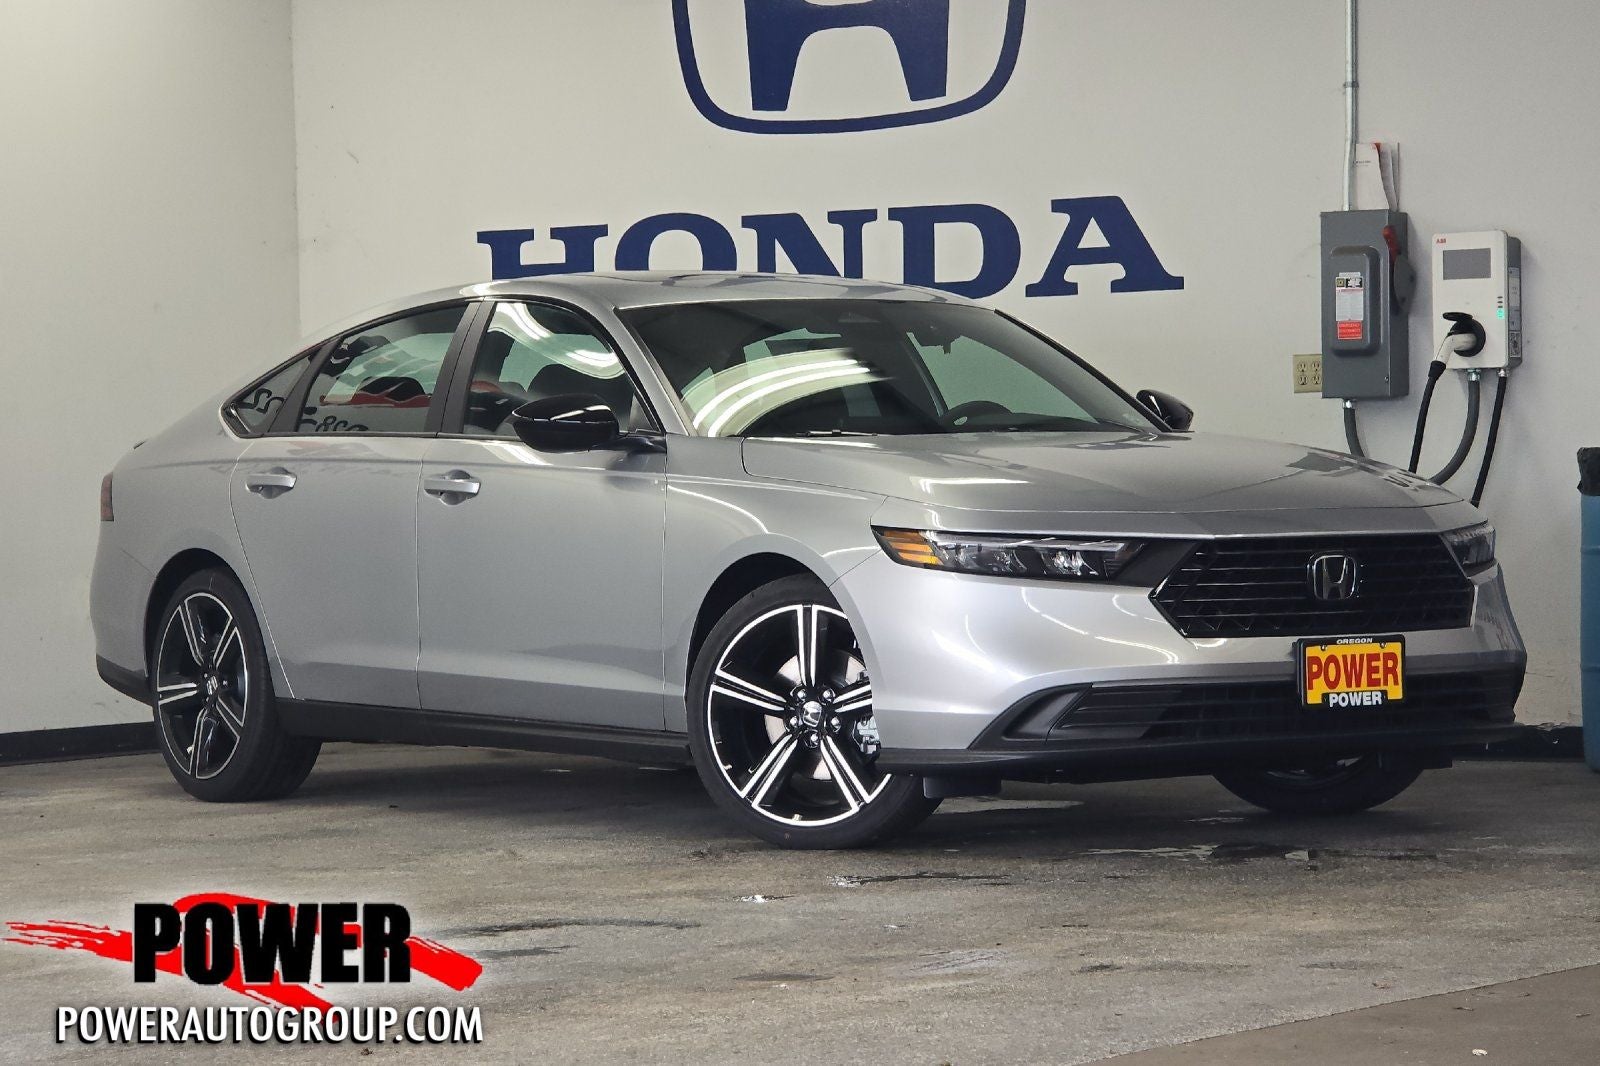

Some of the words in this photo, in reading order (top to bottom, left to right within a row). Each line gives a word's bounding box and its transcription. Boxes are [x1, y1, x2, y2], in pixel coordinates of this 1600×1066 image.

[477, 195, 1184, 299] HONDA
[1336, 637, 1373, 645] OREGON
[1307, 652, 1399, 691] POWER
[1329, 691, 1382, 708] POWER
